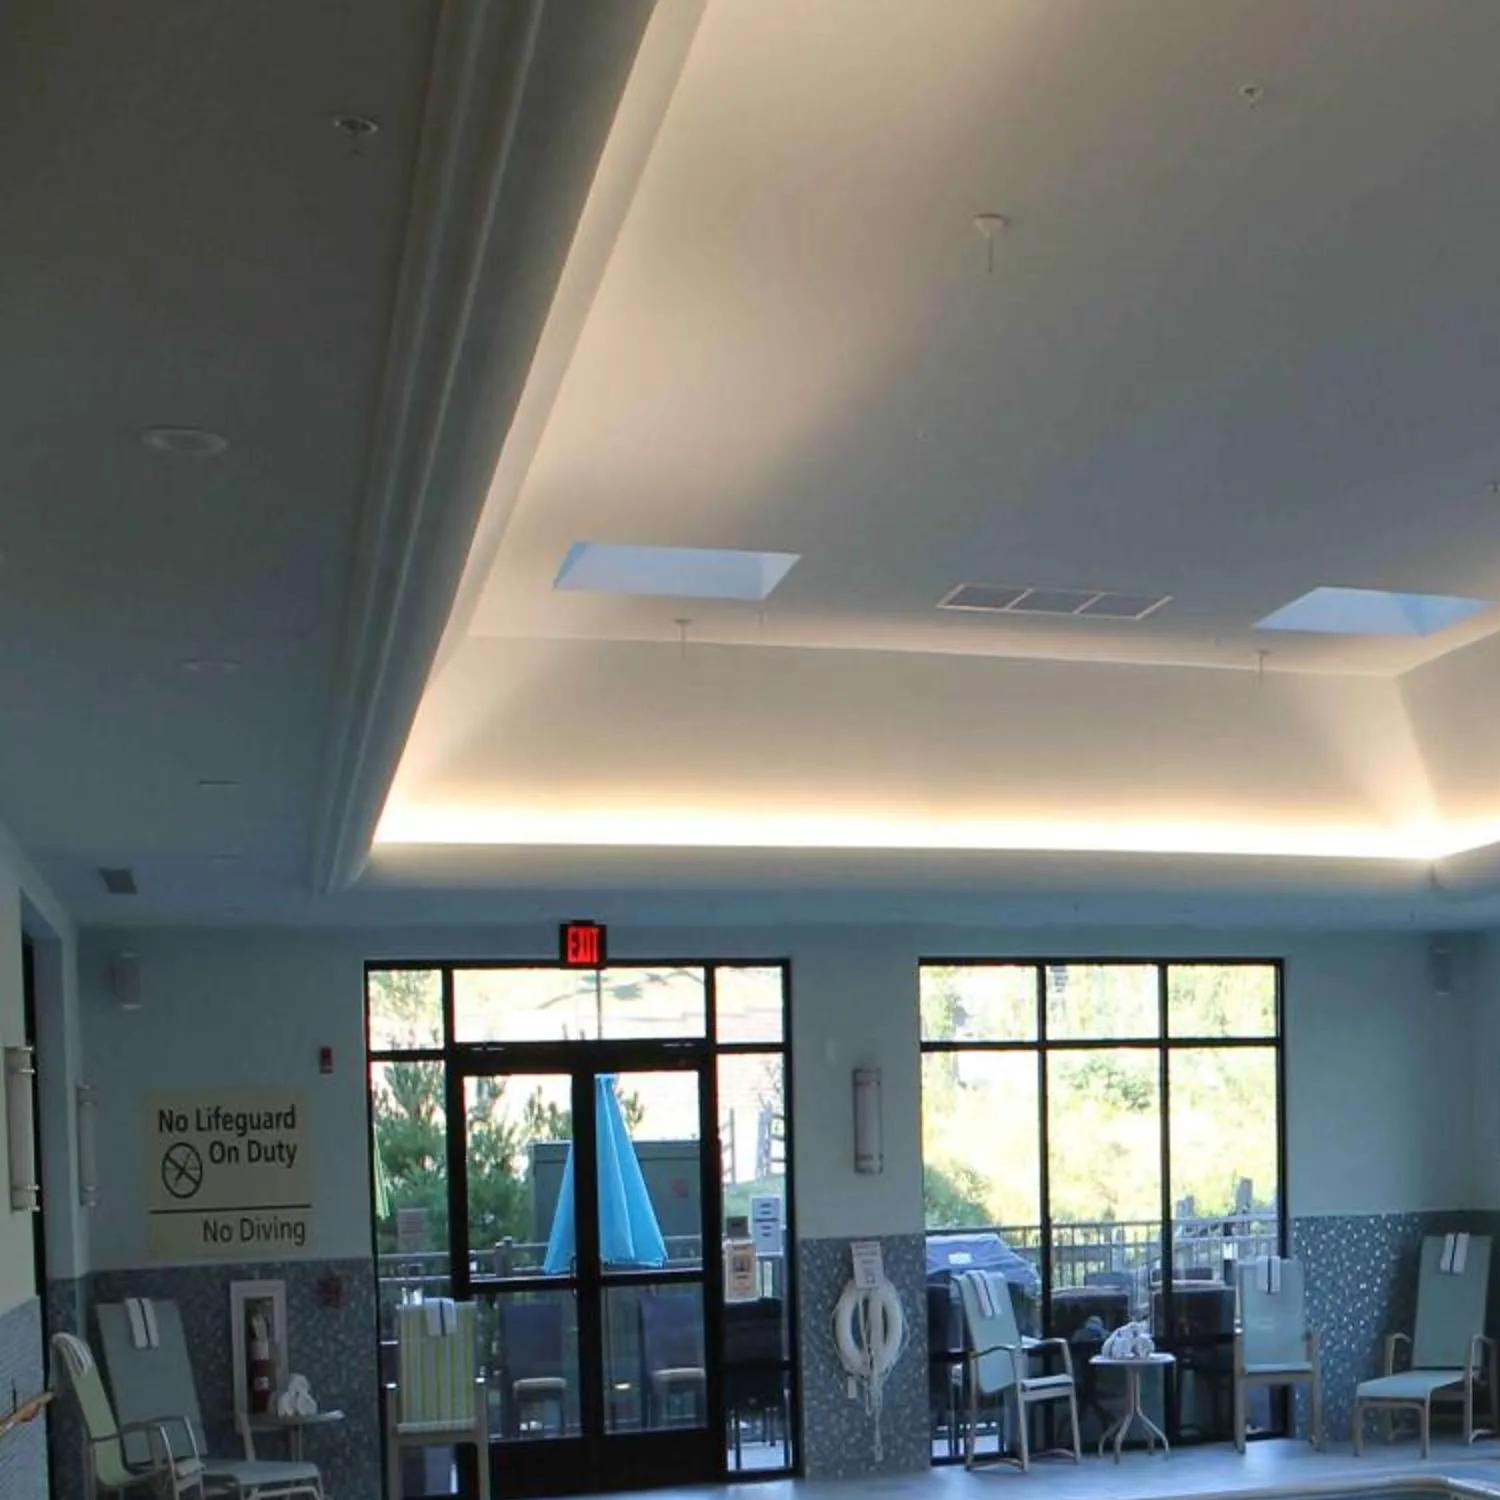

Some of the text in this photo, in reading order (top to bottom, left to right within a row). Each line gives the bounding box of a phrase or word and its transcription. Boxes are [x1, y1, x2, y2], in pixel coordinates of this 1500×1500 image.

[567, 926, 598, 963] EXIT
[158, 1103, 297, 1138] No Lifeguard
[208, 1138, 298, 1169] On Duty
[202, 1215, 306, 1247] No Diving
